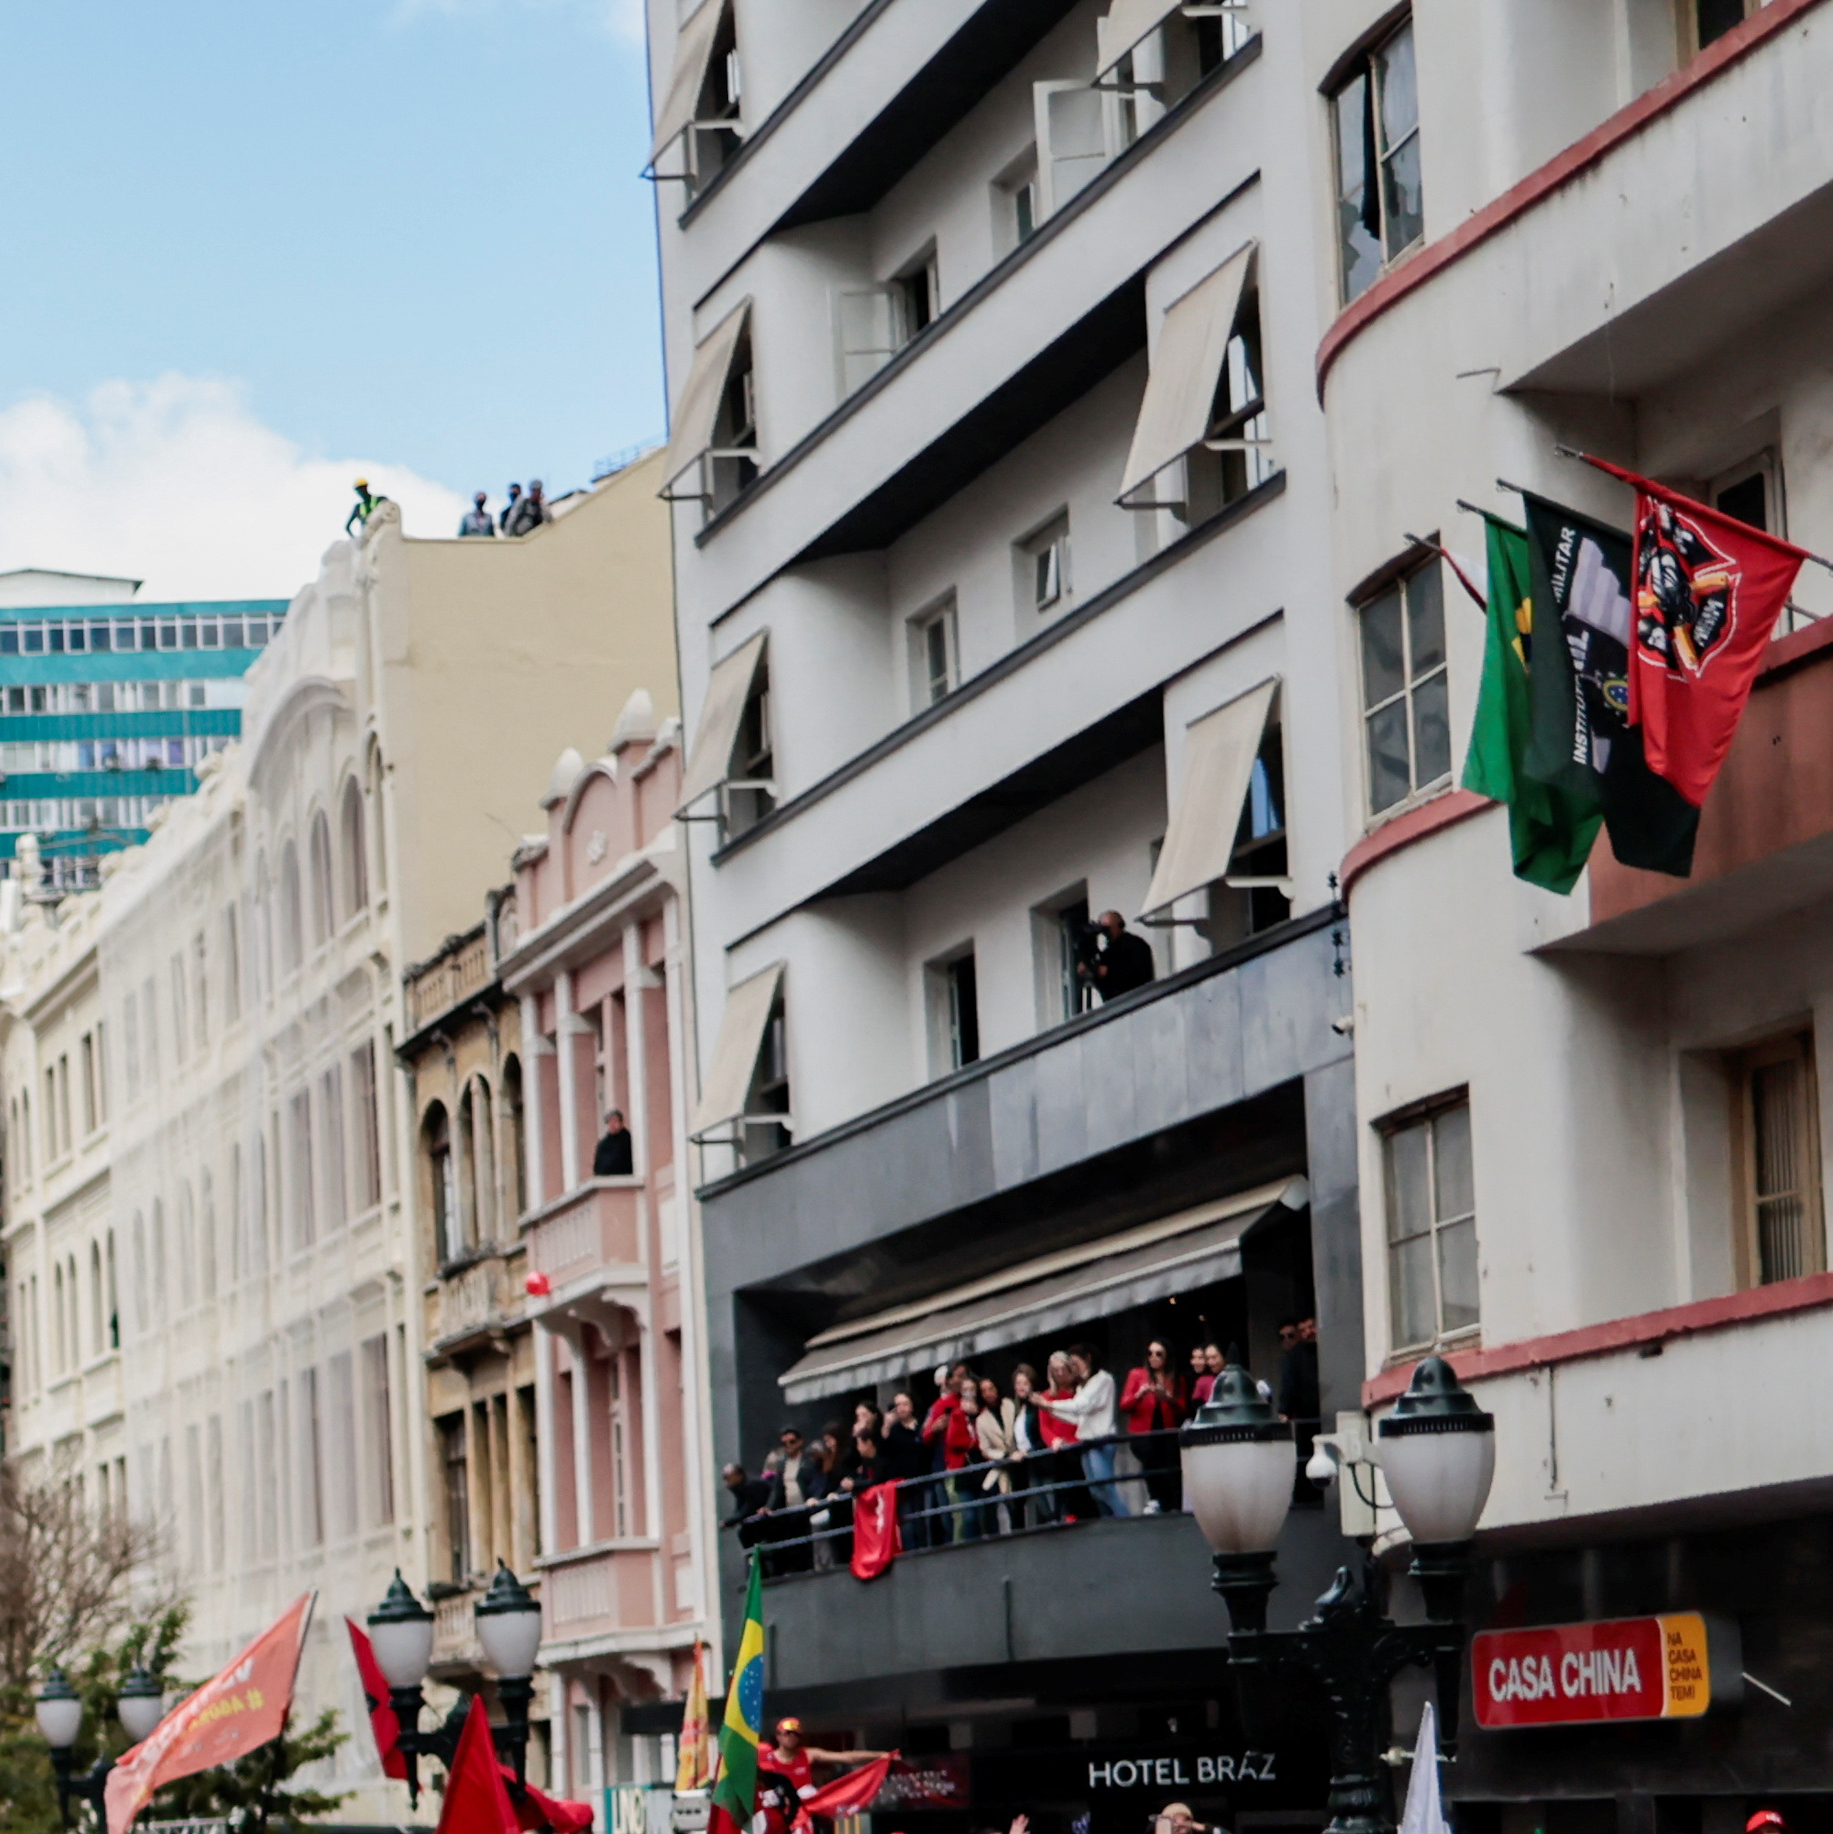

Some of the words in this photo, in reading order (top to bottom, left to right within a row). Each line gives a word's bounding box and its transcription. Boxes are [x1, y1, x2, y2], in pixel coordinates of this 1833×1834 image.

[1667, 1648, 1697, 1666] CASA
[1489, 1654, 1557, 1702] CASA
[1560, 1647, 1643, 1699] CHINA
[1669, 1666, 1704, 1683] CHINA
[1088, 1760, 1190, 1787] HOTEL
